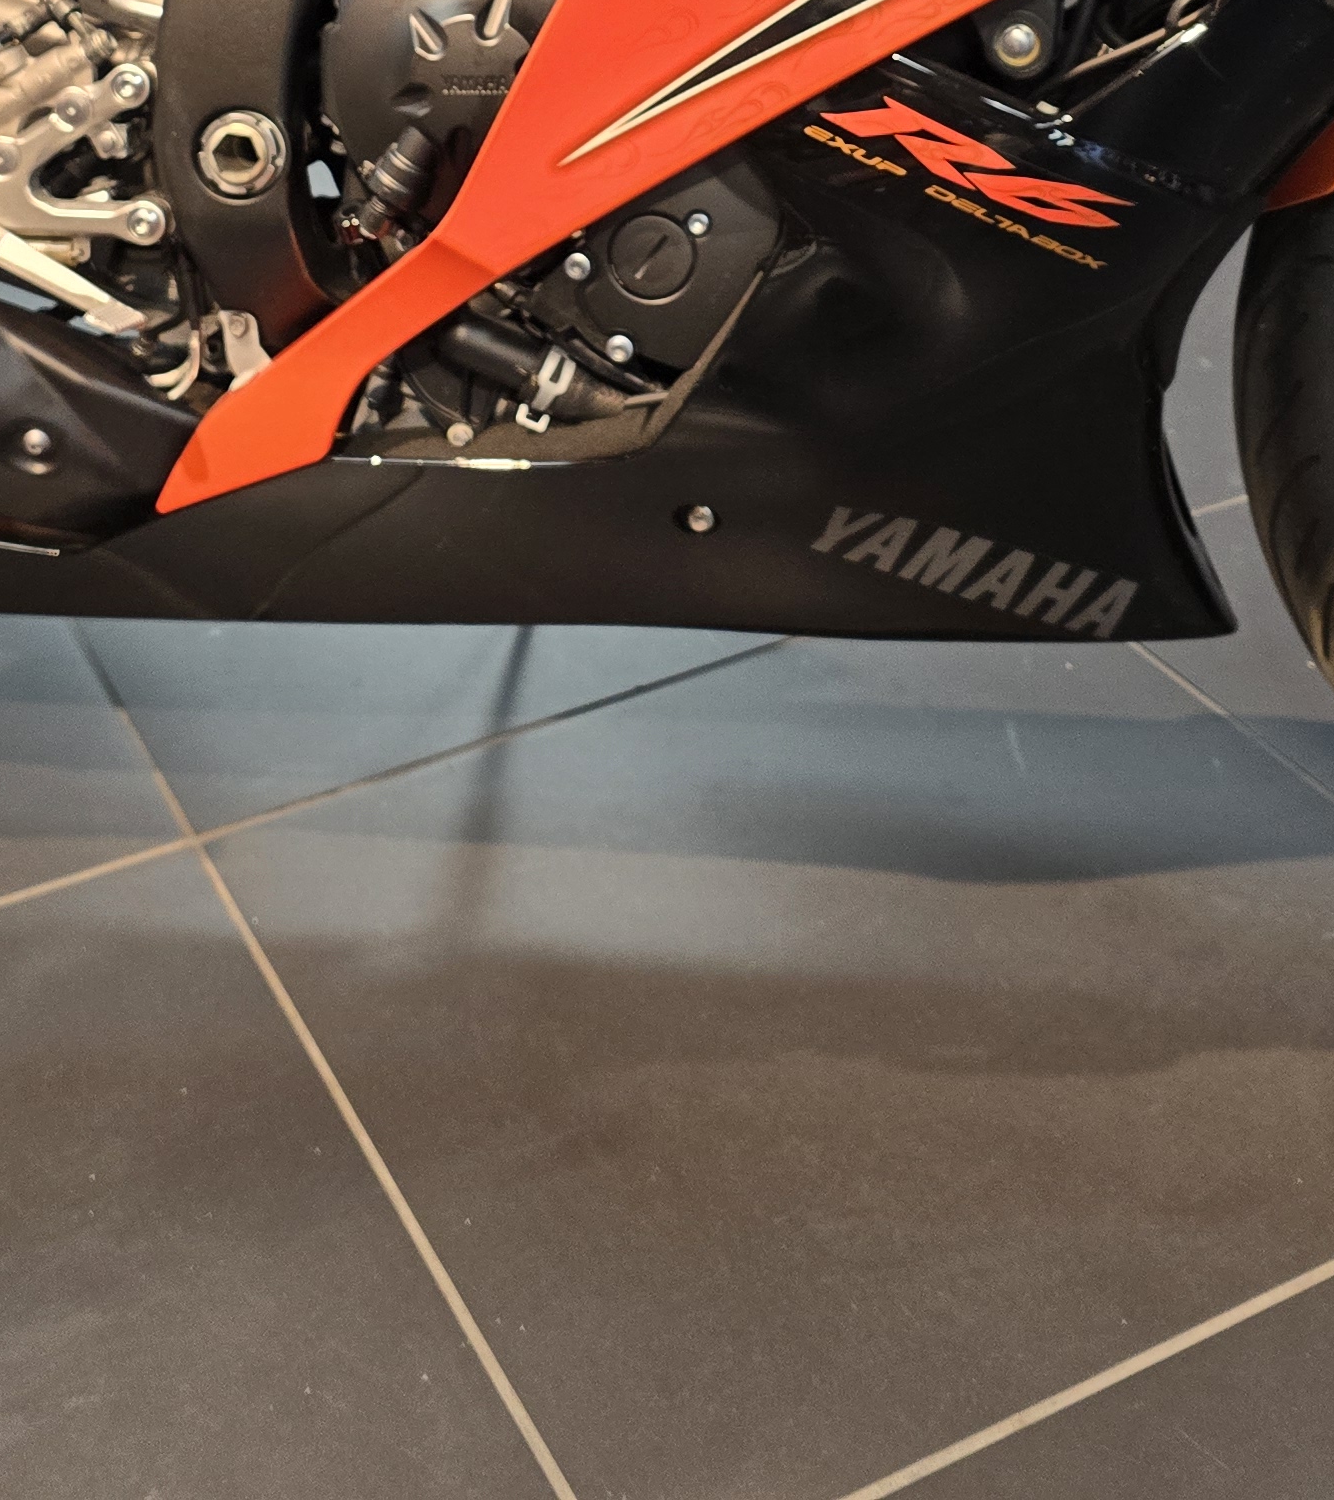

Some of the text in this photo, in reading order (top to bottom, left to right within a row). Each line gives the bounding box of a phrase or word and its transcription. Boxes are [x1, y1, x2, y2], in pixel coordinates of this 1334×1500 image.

[803, 124, 1110, 270] EXUP DELTABOX
[819, 94, 1138, 229] R6
[809, 505, 1139, 640] YAMAHA
